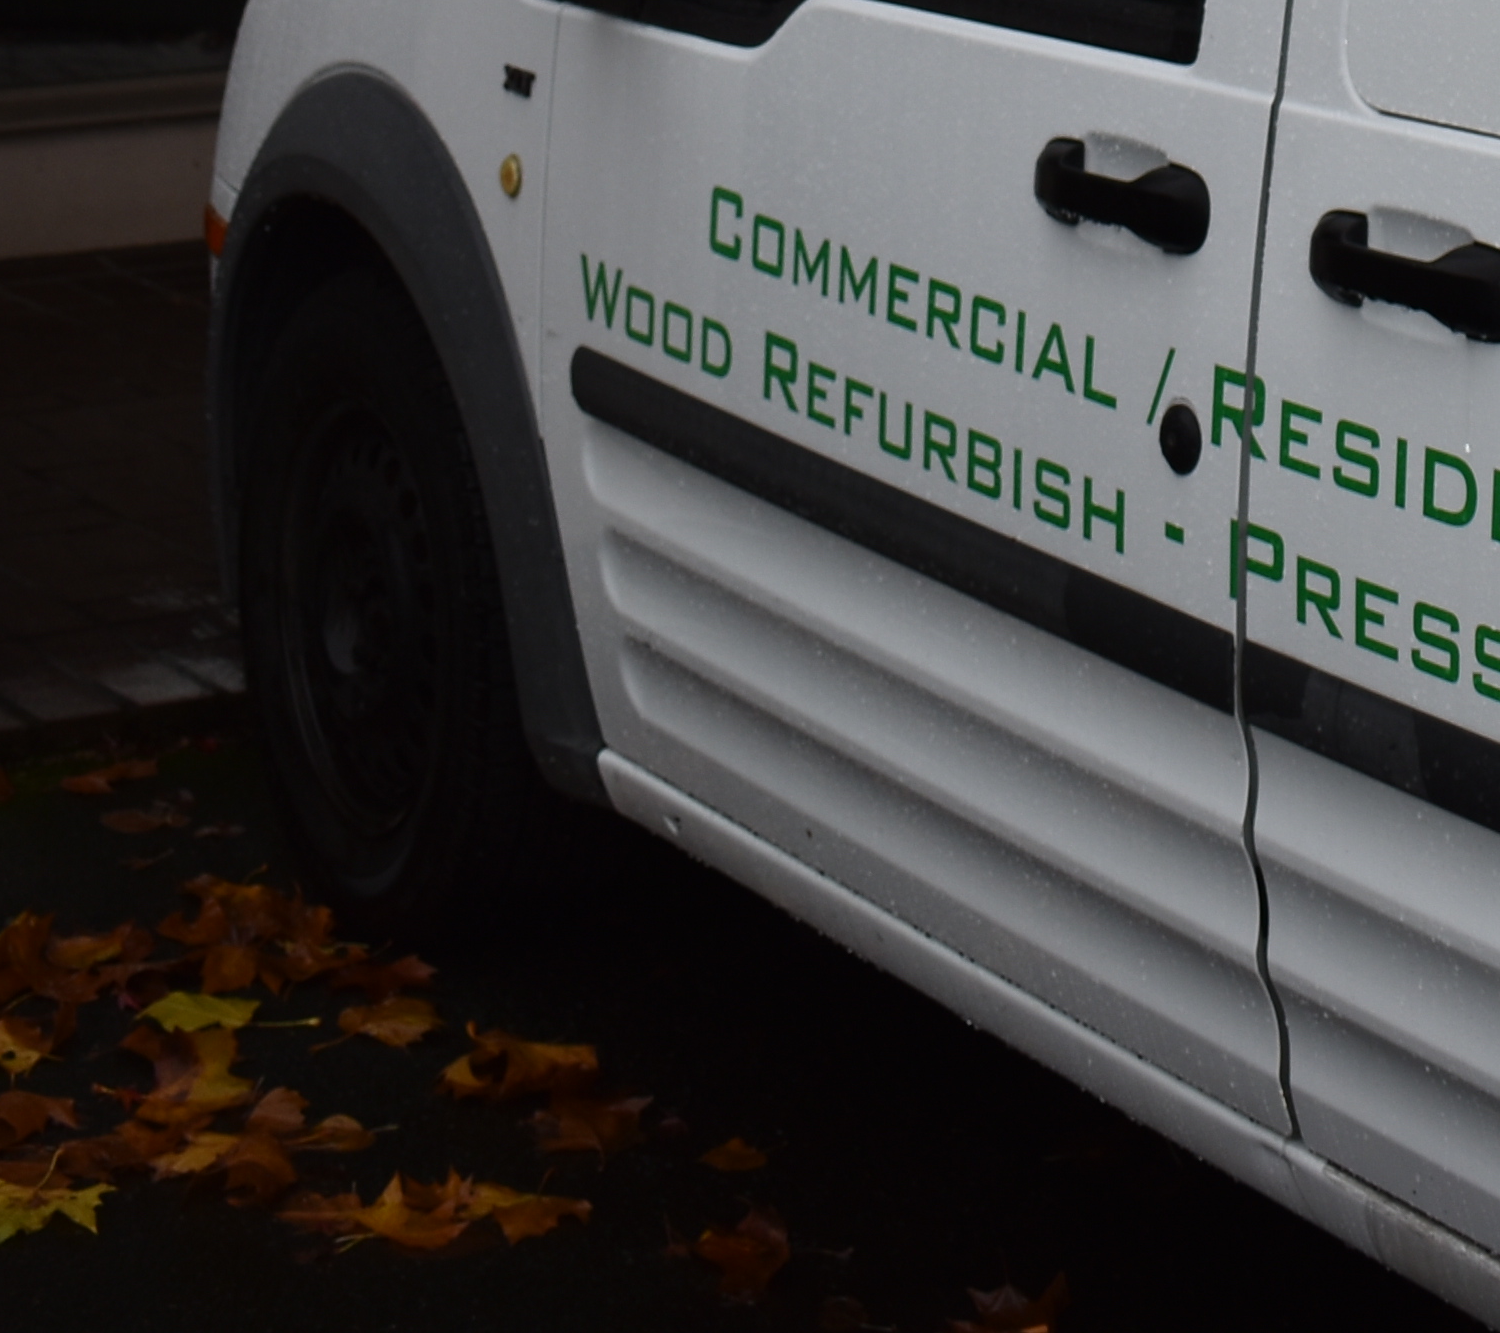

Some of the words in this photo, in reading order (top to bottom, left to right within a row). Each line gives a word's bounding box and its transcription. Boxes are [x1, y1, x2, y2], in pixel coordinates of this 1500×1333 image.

[580, 255, 733, 380] WOOD
[762, 331, 1126, 556] REFURBISH
[709, 187, 1118, 411] COMMERCIAL
